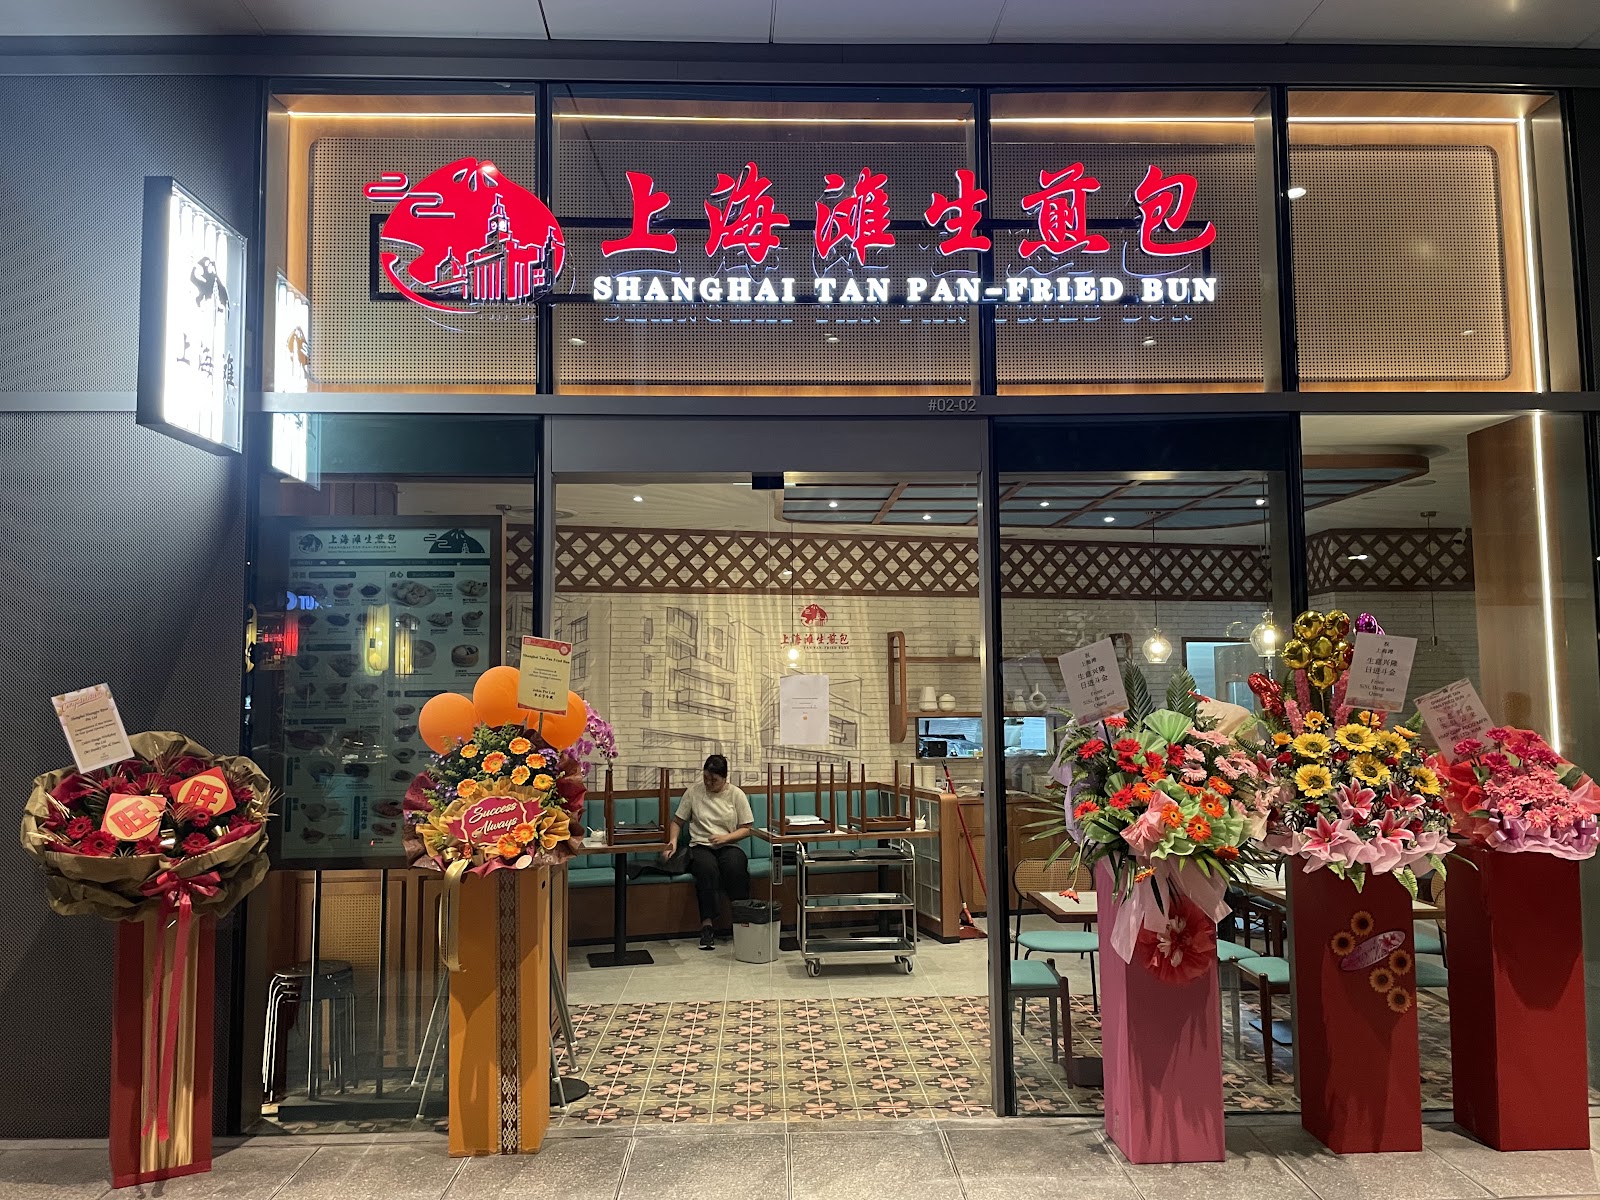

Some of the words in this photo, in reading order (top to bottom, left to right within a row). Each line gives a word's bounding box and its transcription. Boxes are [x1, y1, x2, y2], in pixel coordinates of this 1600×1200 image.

[601, 161, 1217, 266] 上海滩生煎包
[592, 276, 796, 303] SHANGHAI
[814, 277, 891, 303] TAN
[906, 277, 1125, 303] PAN-FRIED
[1140, 277, 1218, 303] BUN
[928, 399, 977, 413] #02-02
[183, 780, 224, 809] 旺
[110, 800, 159, 838] 旺
[469, 801, 517, 824] Success
[471, 817, 518, 838] Always
